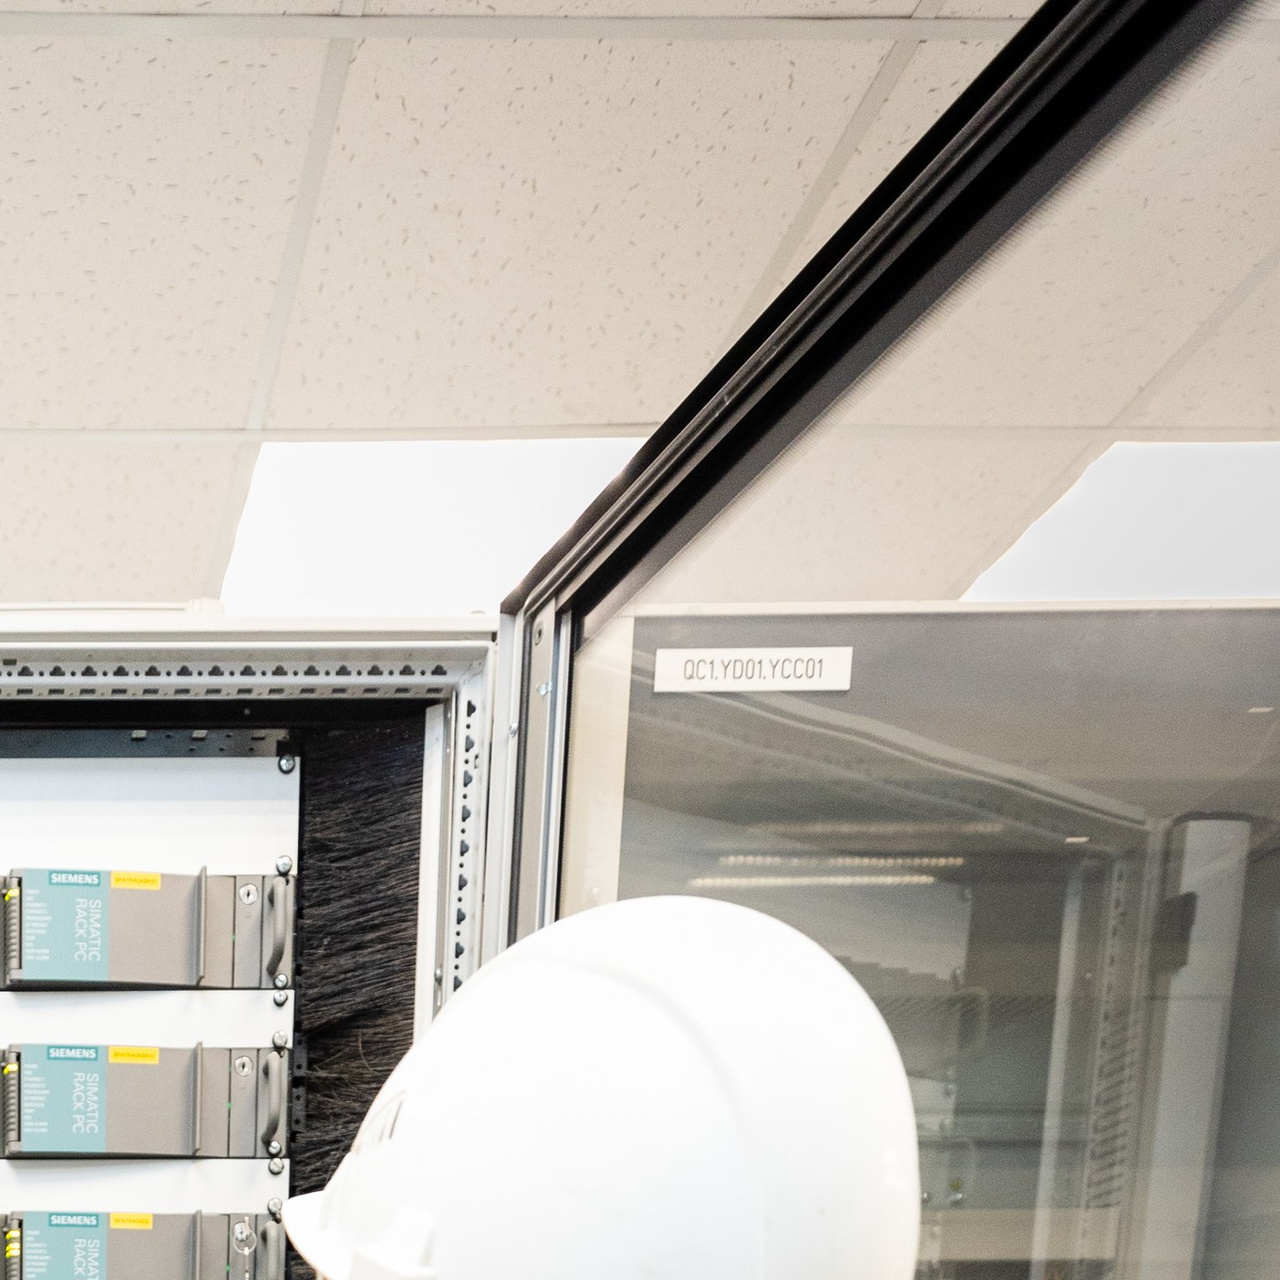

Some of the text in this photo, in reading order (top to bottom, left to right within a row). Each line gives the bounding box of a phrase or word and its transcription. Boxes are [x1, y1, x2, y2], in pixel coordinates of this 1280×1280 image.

[683, 658, 824, 681] QC1.YD01.YCC01
[50, 873, 99, 885] SIEMENS
[74, 898, 88, 962] RACK PC
[88, 899, 102, 962] SIMATIC
[49, 1048, 97, 1059] SIEMENS
[72, 1072, 85, 1133] RACK PC
[86, 1072, 100, 1133] SIMATIC
[50, 1214, 98, 1225] SIEMENS
[73, 1238, 86, 1275] RACK
